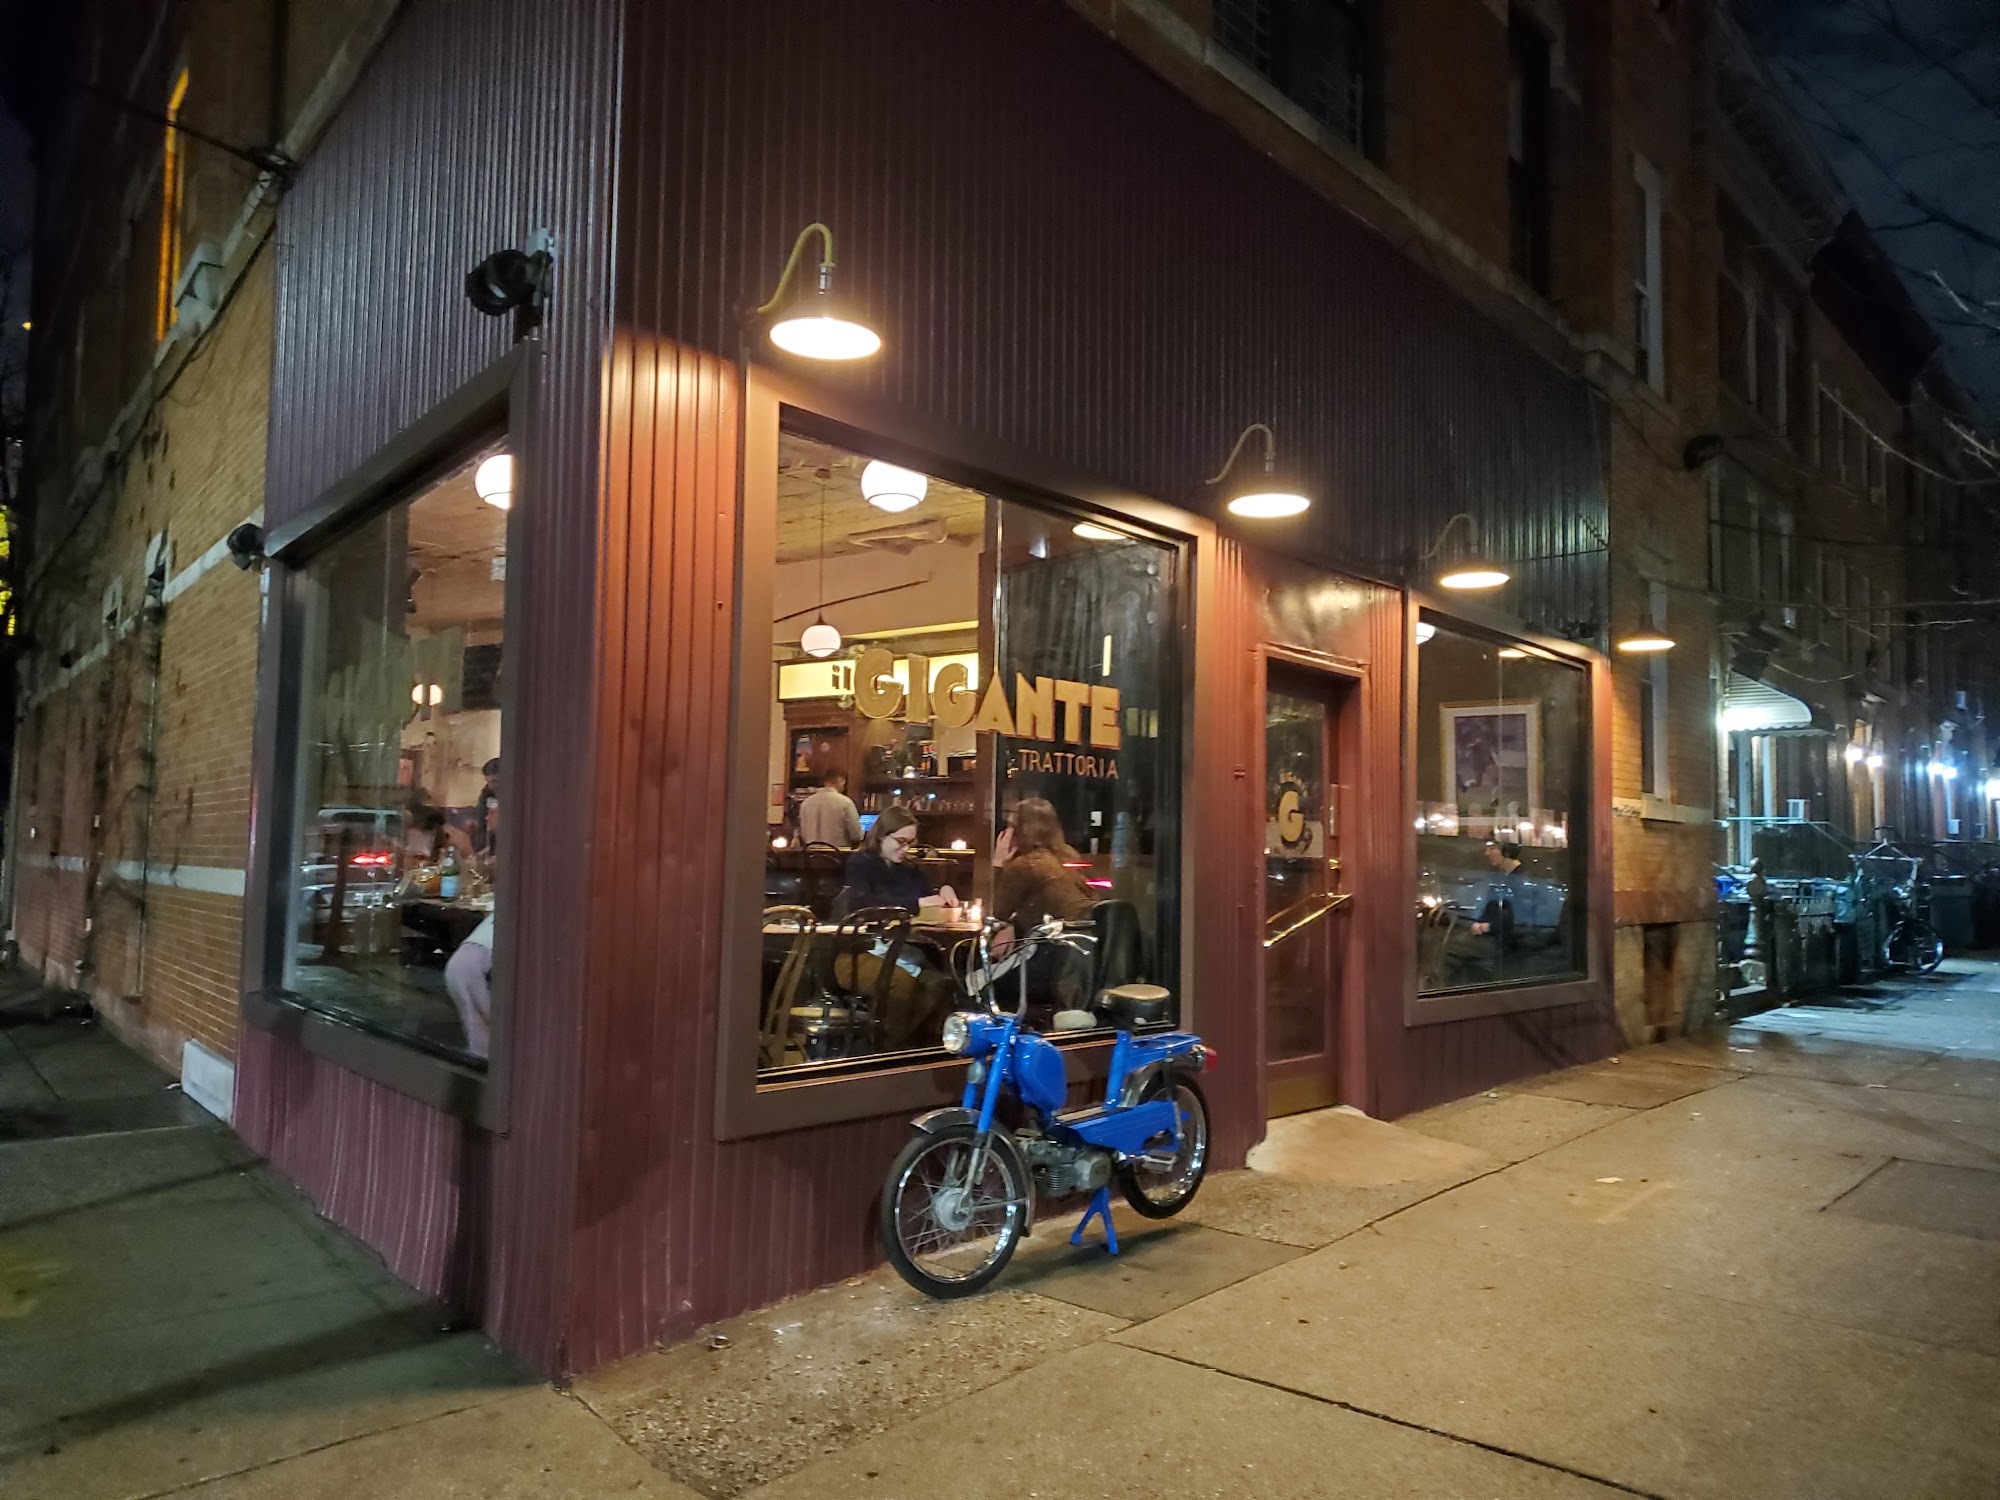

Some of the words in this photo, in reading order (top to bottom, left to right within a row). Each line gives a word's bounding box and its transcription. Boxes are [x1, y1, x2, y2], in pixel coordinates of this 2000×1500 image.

[831, 664, 851, 690] il
[854, 648, 1121, 750] GIGANTE
[1018, 749, 1119, 779] TRATTORIA
[1278, 790, 1305, 842] G
